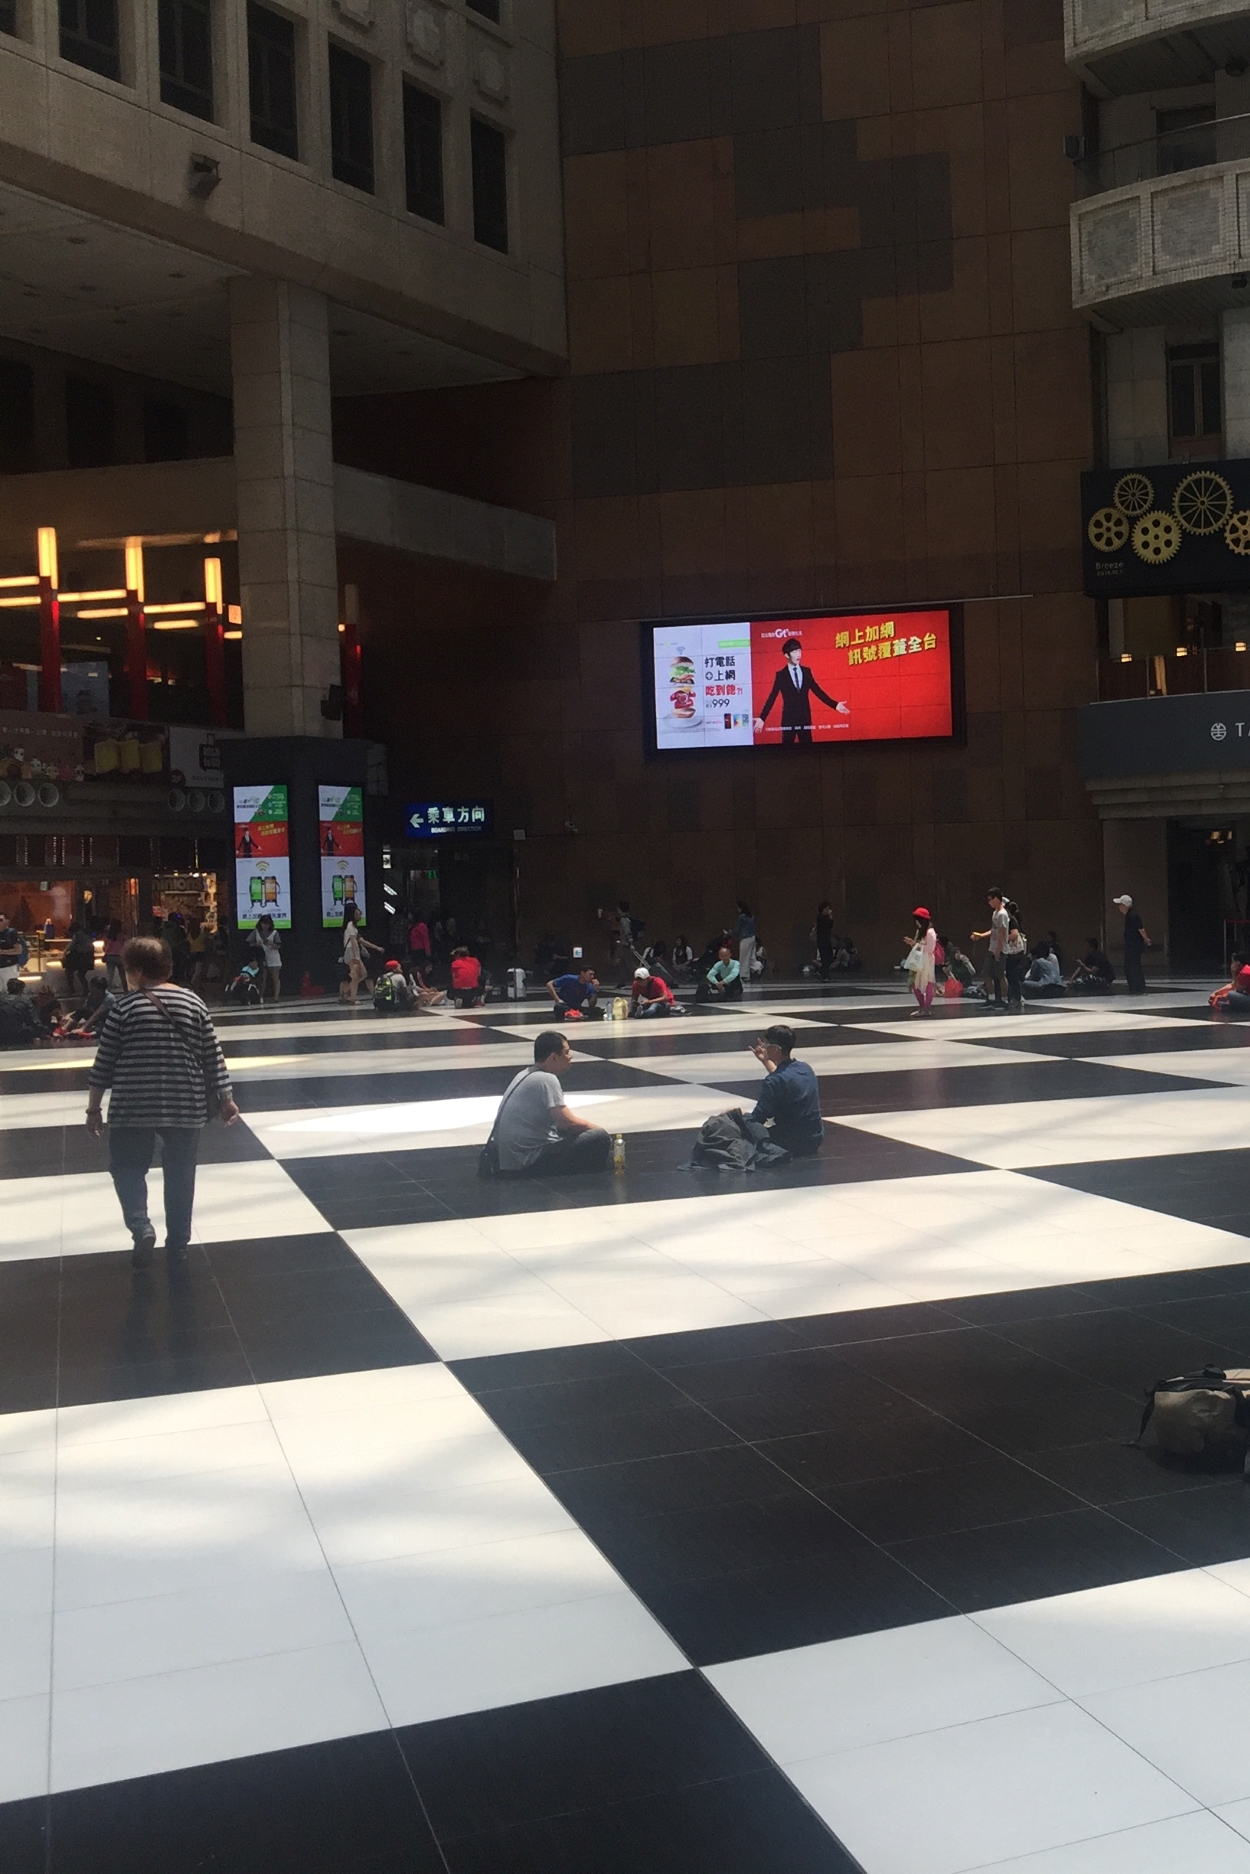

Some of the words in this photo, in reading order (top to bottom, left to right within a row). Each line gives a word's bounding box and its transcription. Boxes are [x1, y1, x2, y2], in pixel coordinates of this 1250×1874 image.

[1095, 561, 1124, 570] Breeze
[835, 621, 894, 648] 網上加網
[848, 632, 936, 665] 訊號覆蓋全台
[704, 655, 736, 667] 打電話
[714, 670, 735, 681] 上網
[712, 699, 730, 708] 999
[427, 805, 485, 824] 乘車方向
